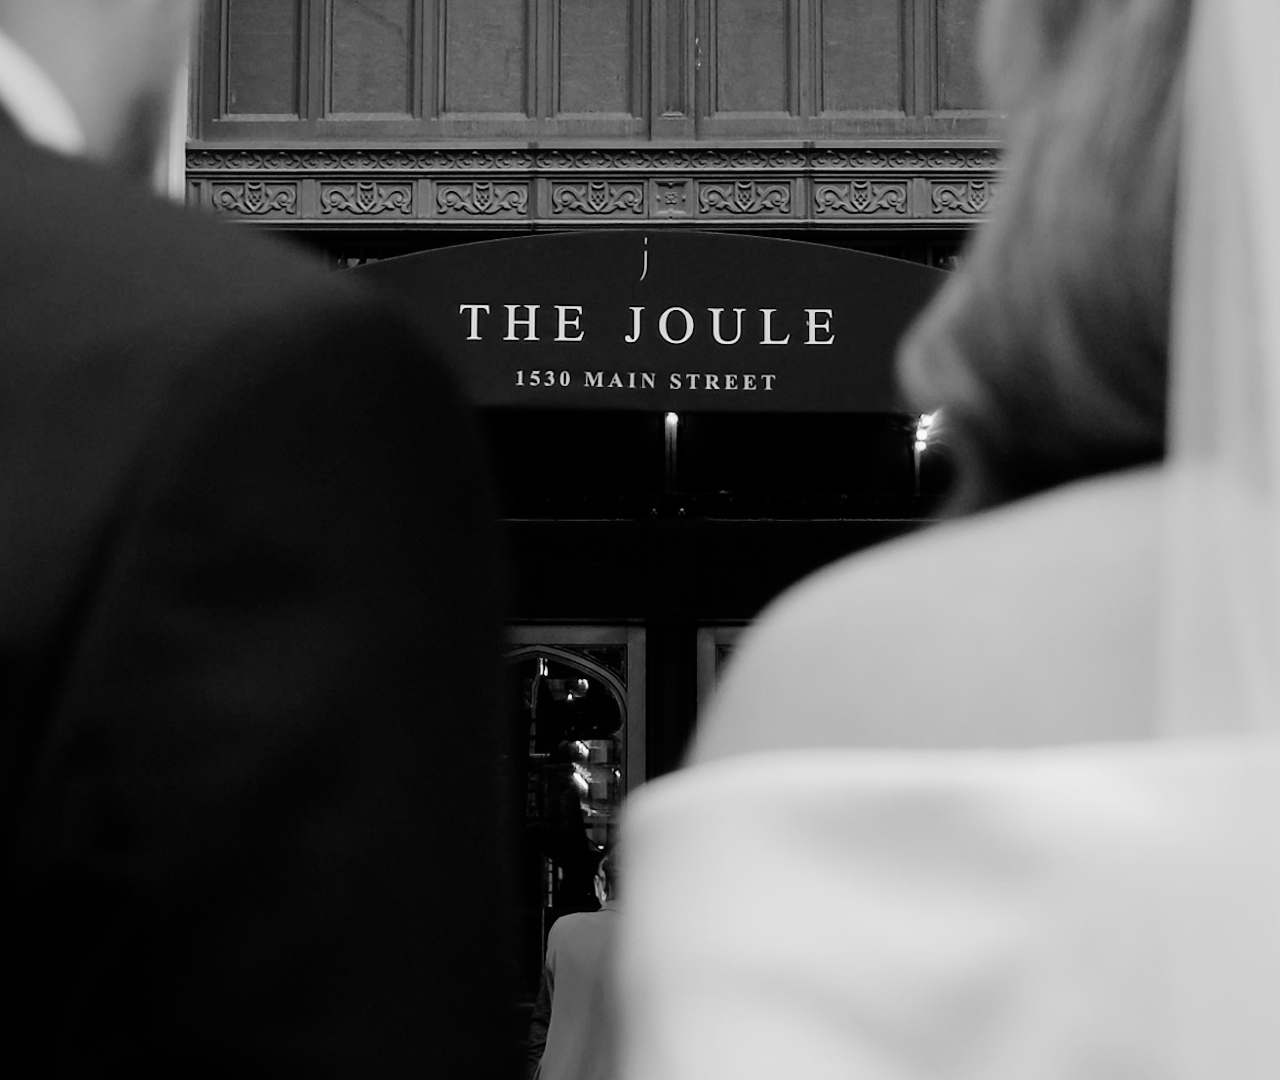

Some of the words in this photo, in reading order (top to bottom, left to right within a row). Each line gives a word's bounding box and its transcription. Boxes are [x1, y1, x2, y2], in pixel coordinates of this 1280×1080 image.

[459, 304, 585, 342] THE
[624, 306, 835, 345] JOULE
[515, 370, 571, 387] 1530
[583, 371, 656, 390] MAIN
[669, 372, 776, 391] STREET
